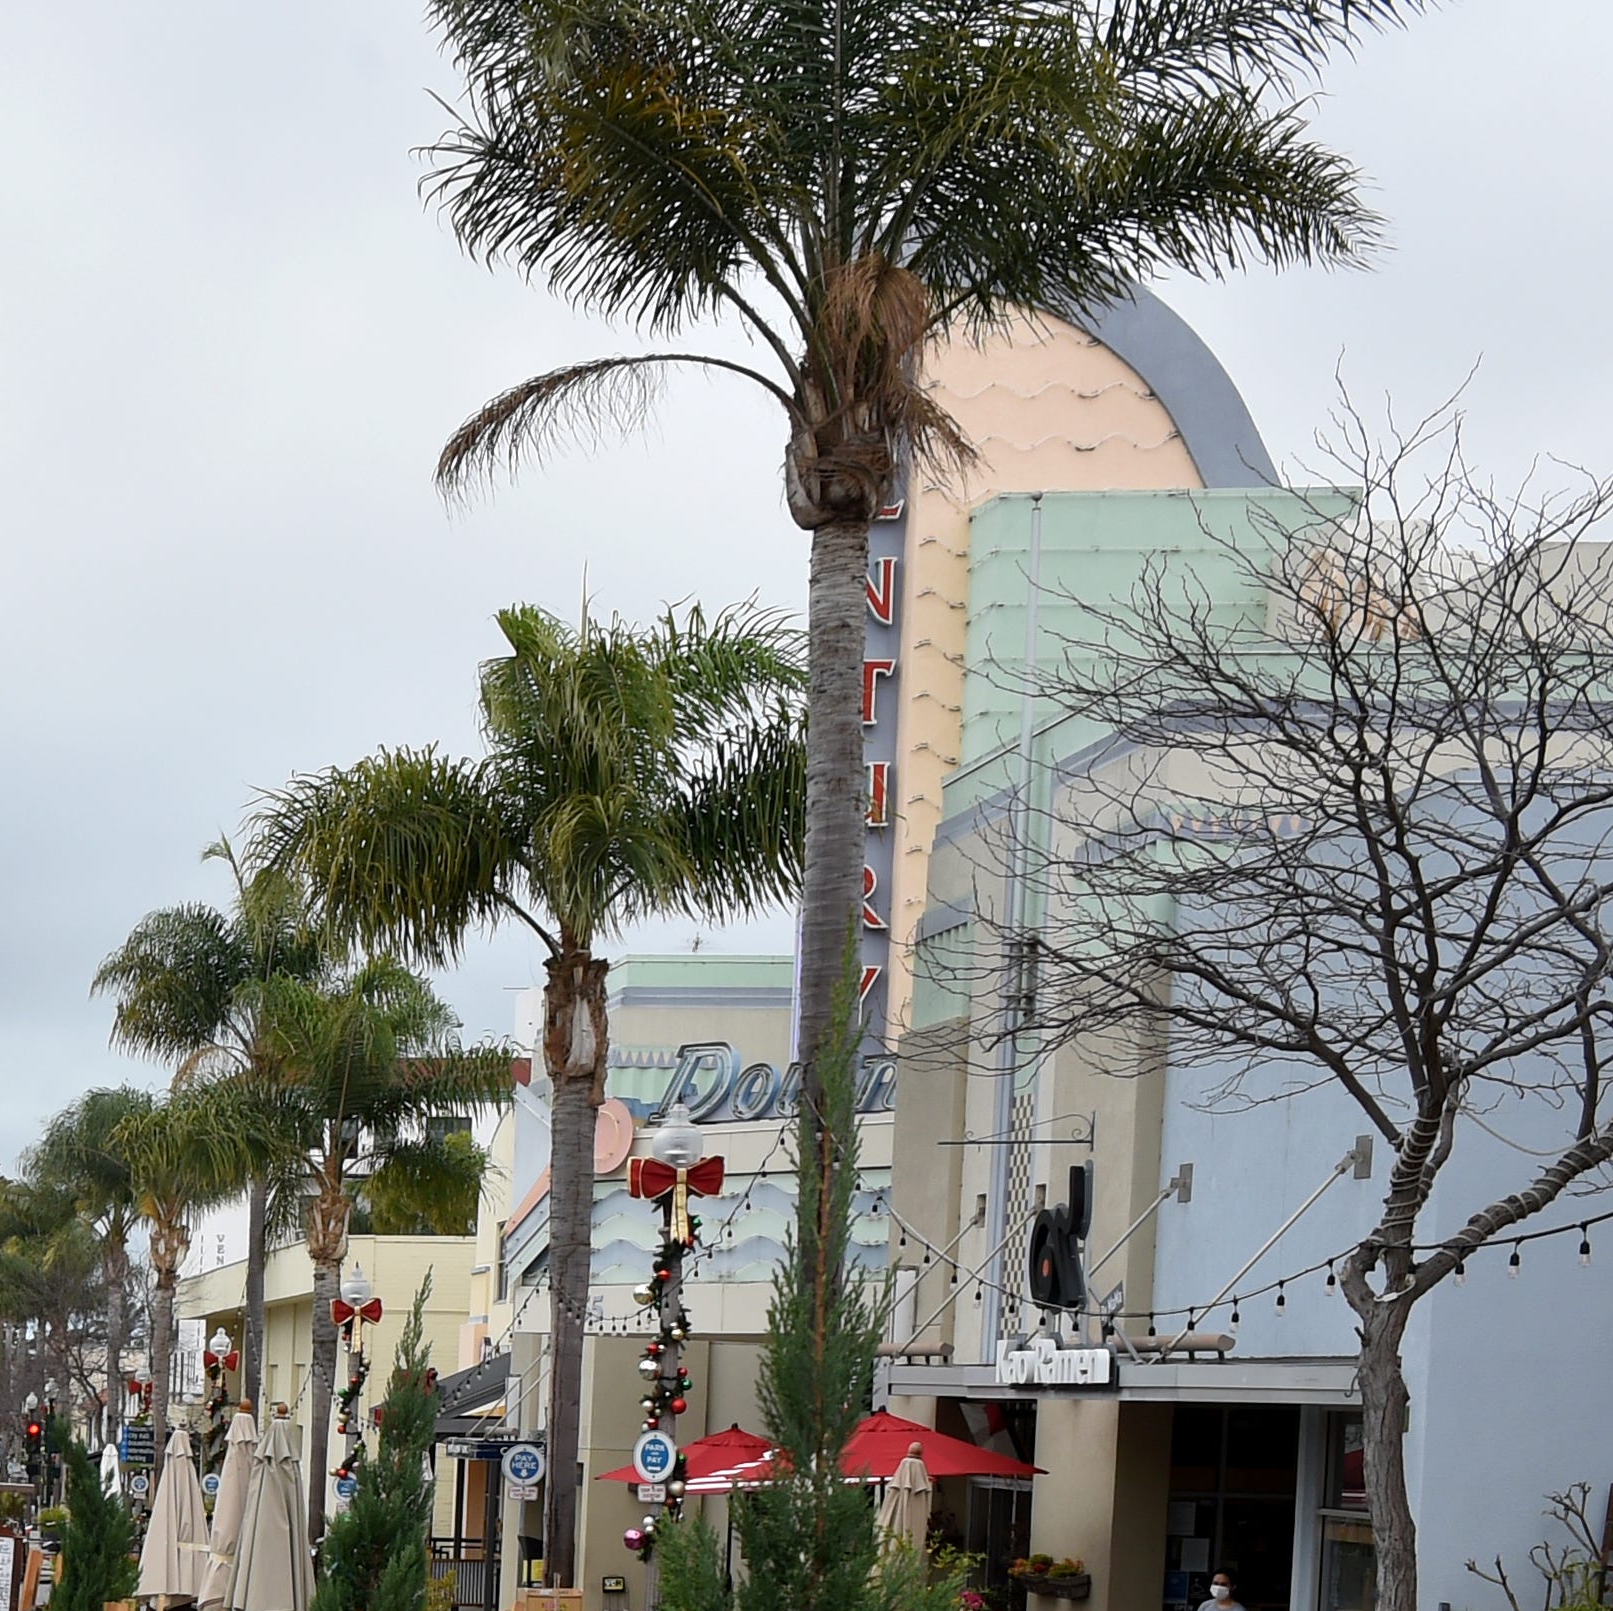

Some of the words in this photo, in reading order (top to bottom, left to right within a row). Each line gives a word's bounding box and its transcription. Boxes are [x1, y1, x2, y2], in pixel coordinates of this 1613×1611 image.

[996, 1339, 1033, 1384] Kao
[1034, 1338, 1109, 1385] Ramen
[644, 1443, 665, 1451] PARK
[514, 1454, 534, 1462] PAY
[646, 1456, 662, 1464] PAY
[511, 1461, 537, 1470] HERE
